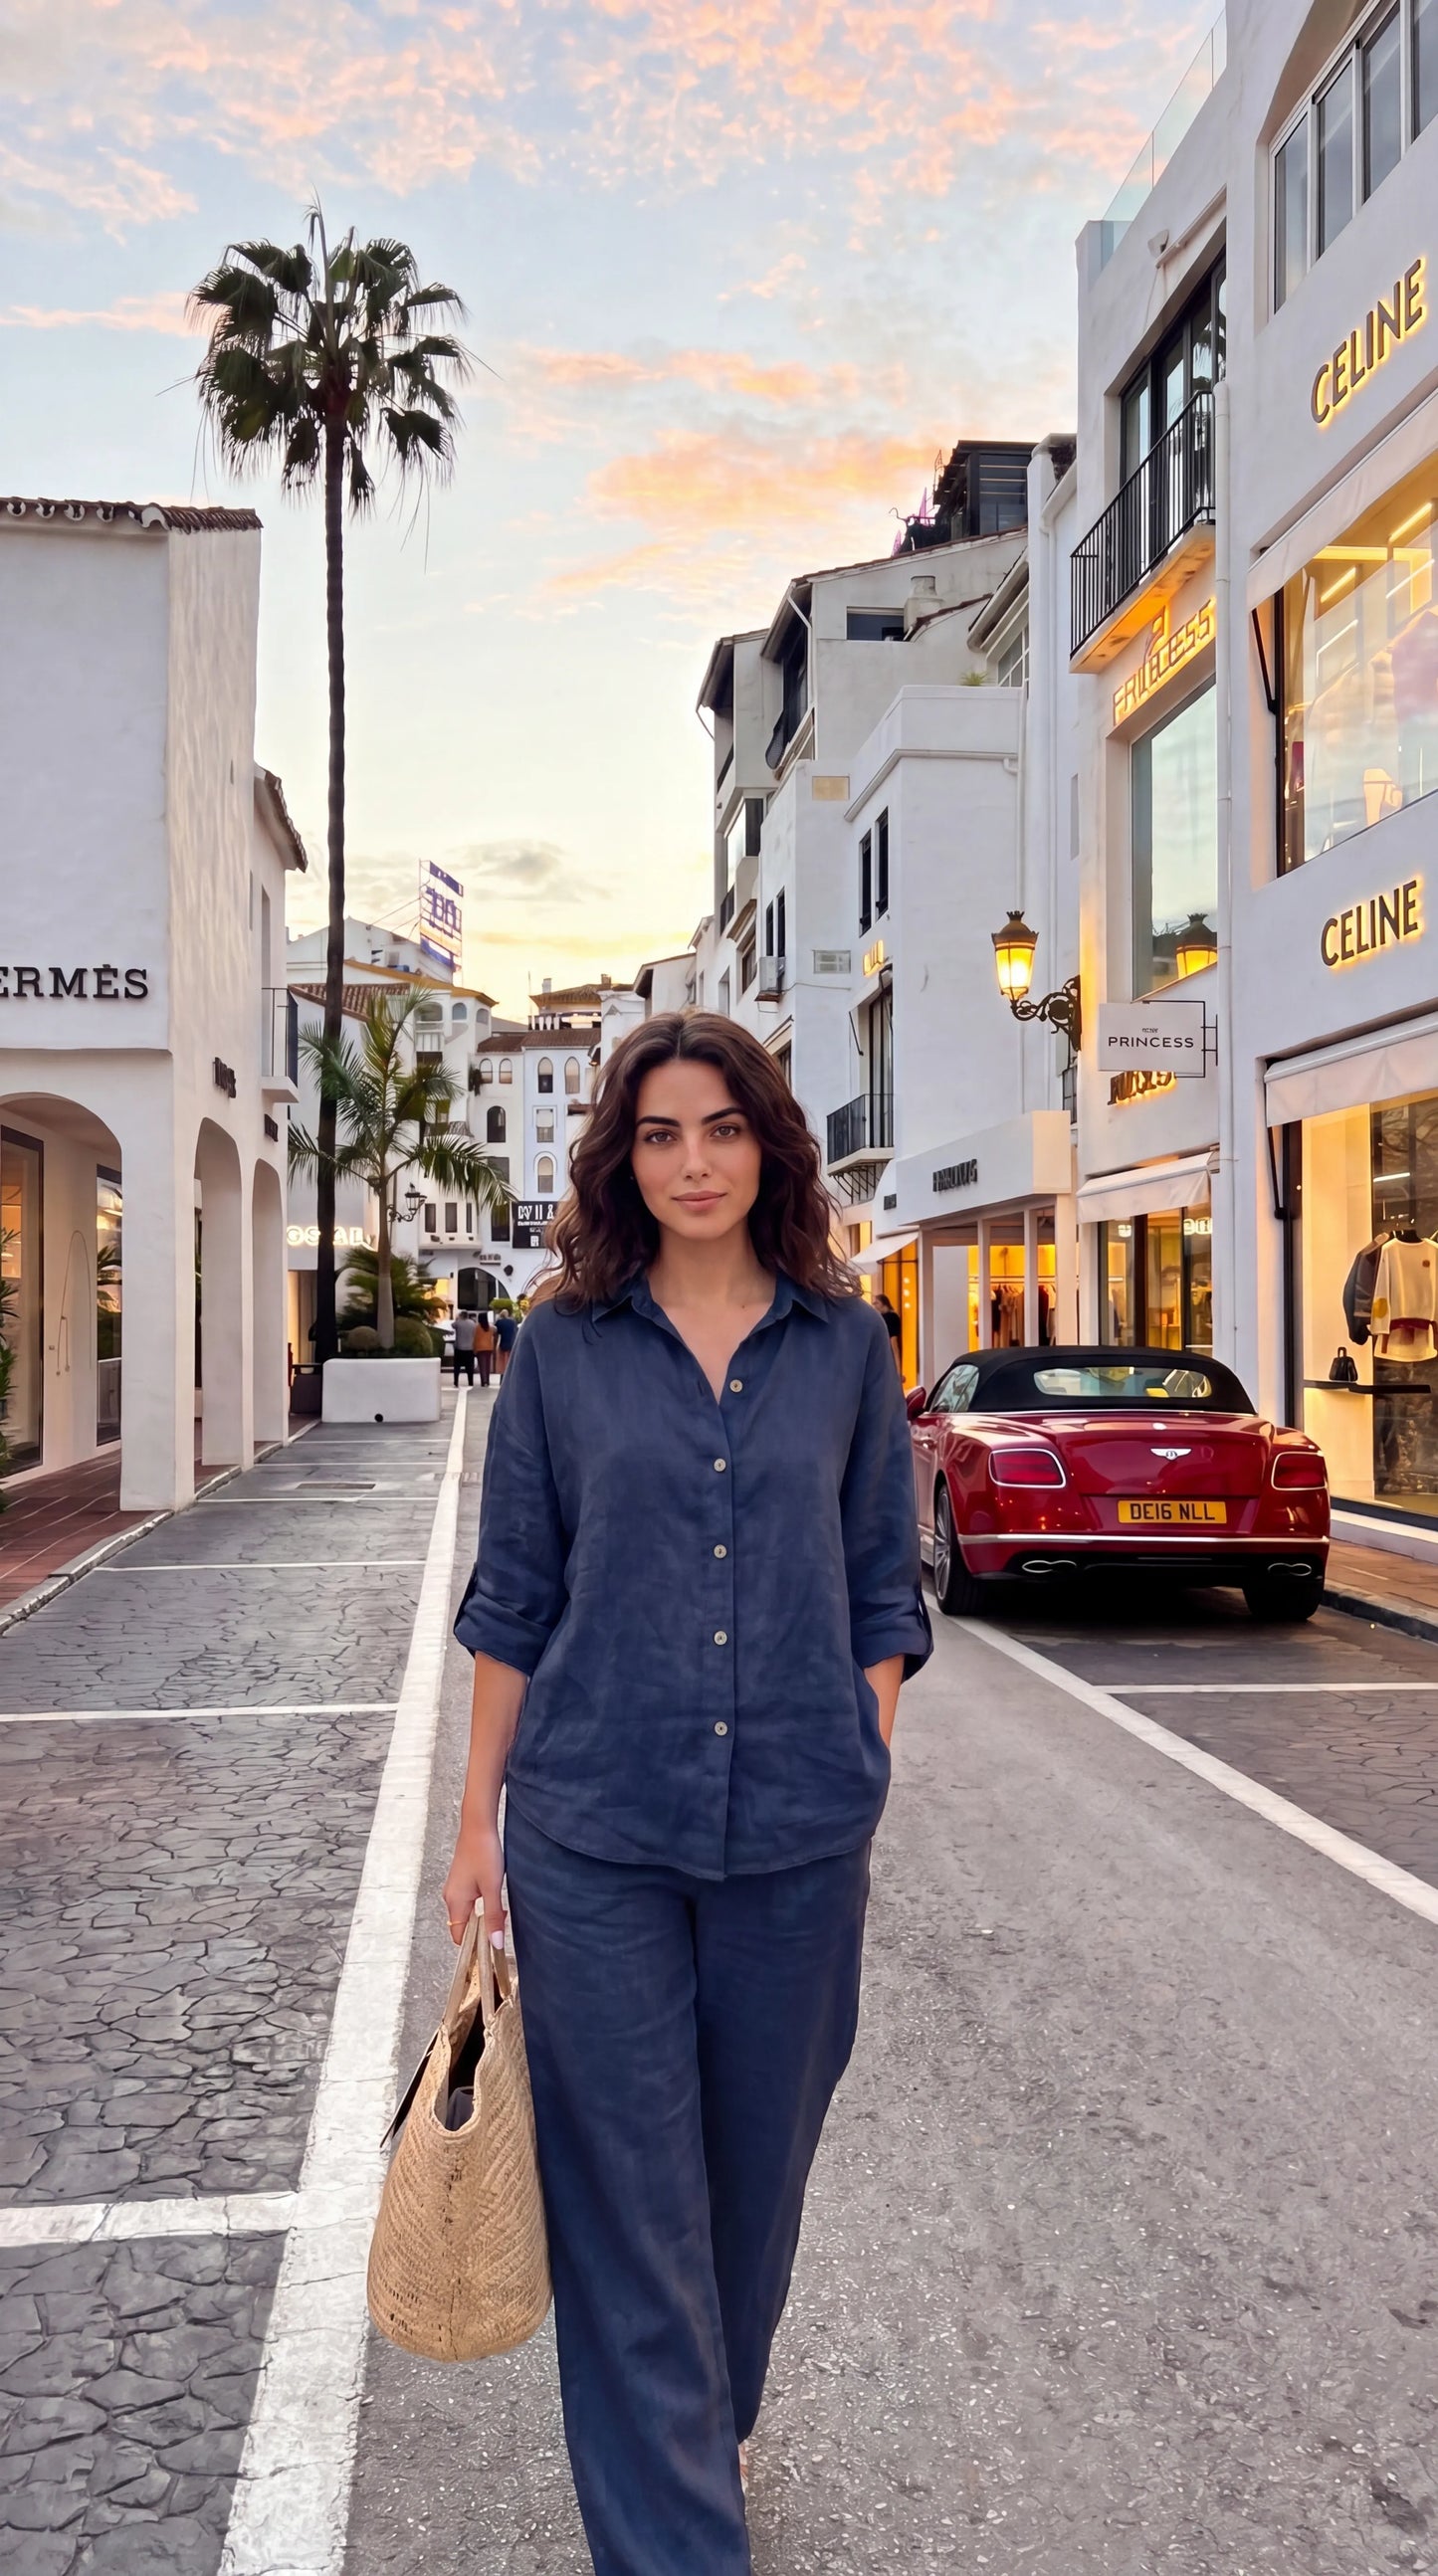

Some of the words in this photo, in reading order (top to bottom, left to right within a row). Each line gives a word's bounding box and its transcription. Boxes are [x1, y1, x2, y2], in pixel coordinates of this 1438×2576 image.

[1311, 259, 1422, 424] CELINE
[1321, 880, 1418, 966] CELINE
[1108, 1036, 1194, 1048] PRINCESS
[1130, 1502, 1172, 1520] DE16
[1179, 1502, 1216, 1520] NLL
